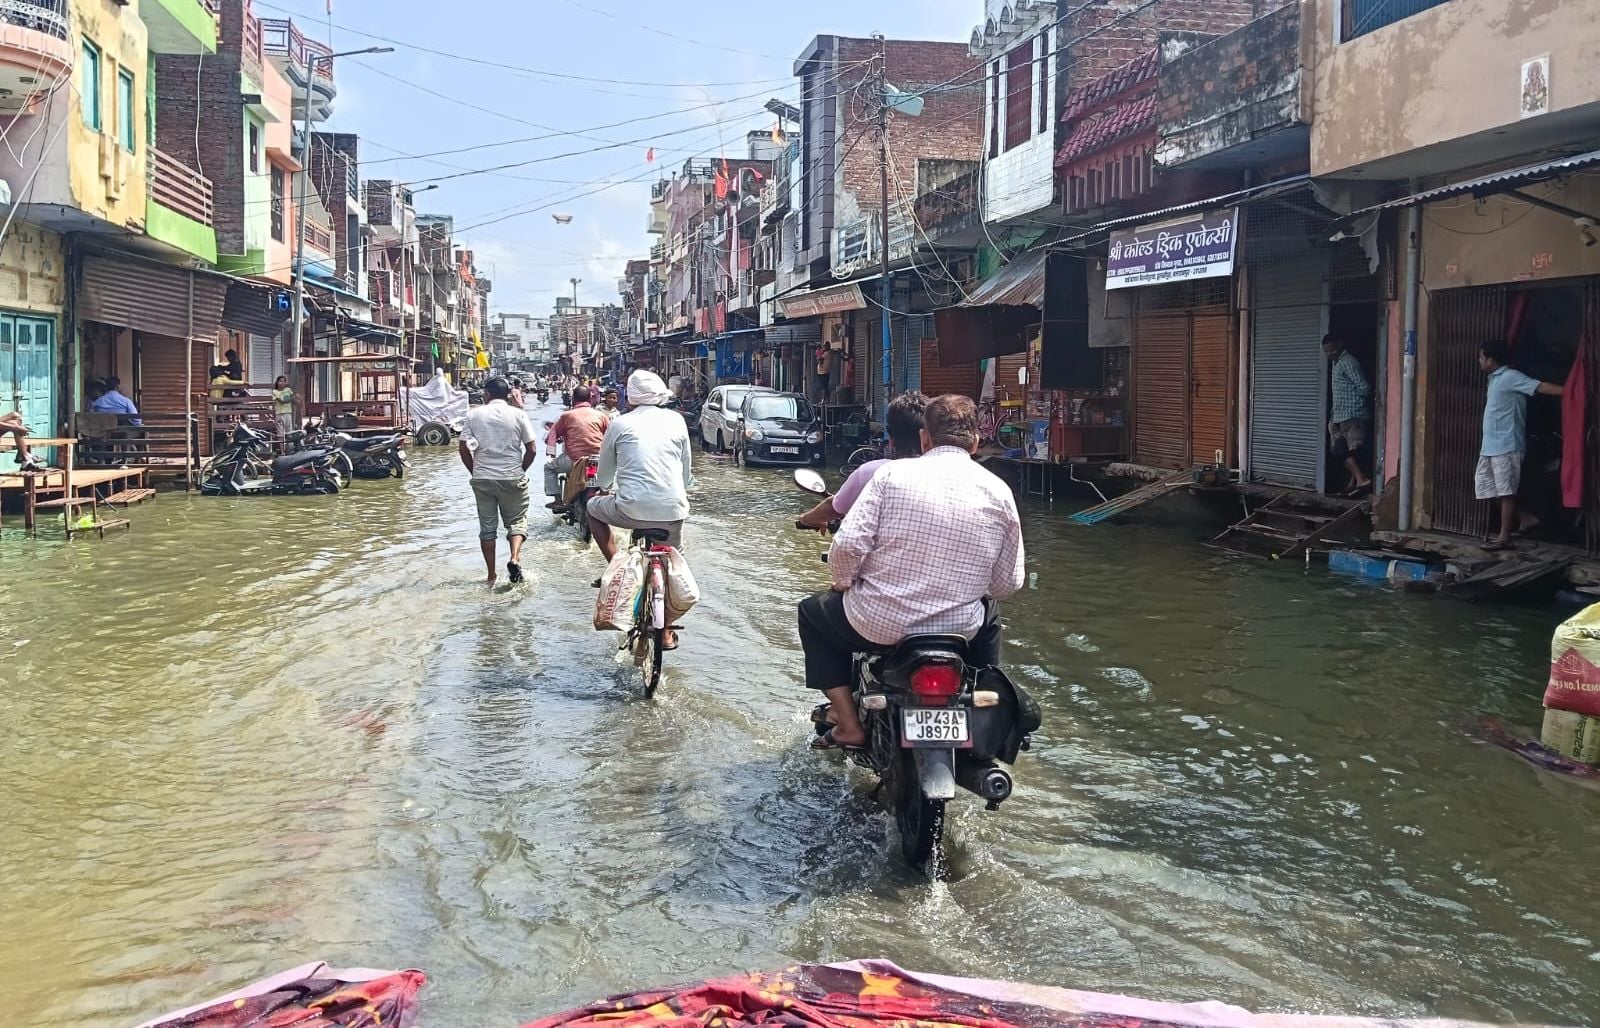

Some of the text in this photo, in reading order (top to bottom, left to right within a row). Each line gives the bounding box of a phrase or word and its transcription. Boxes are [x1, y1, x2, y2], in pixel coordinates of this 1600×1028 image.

[1109, 219, 1231, 261] श्री कोल्ड ड्रिंक एजेन्सी
[917, 725, 960, 739] J8970
